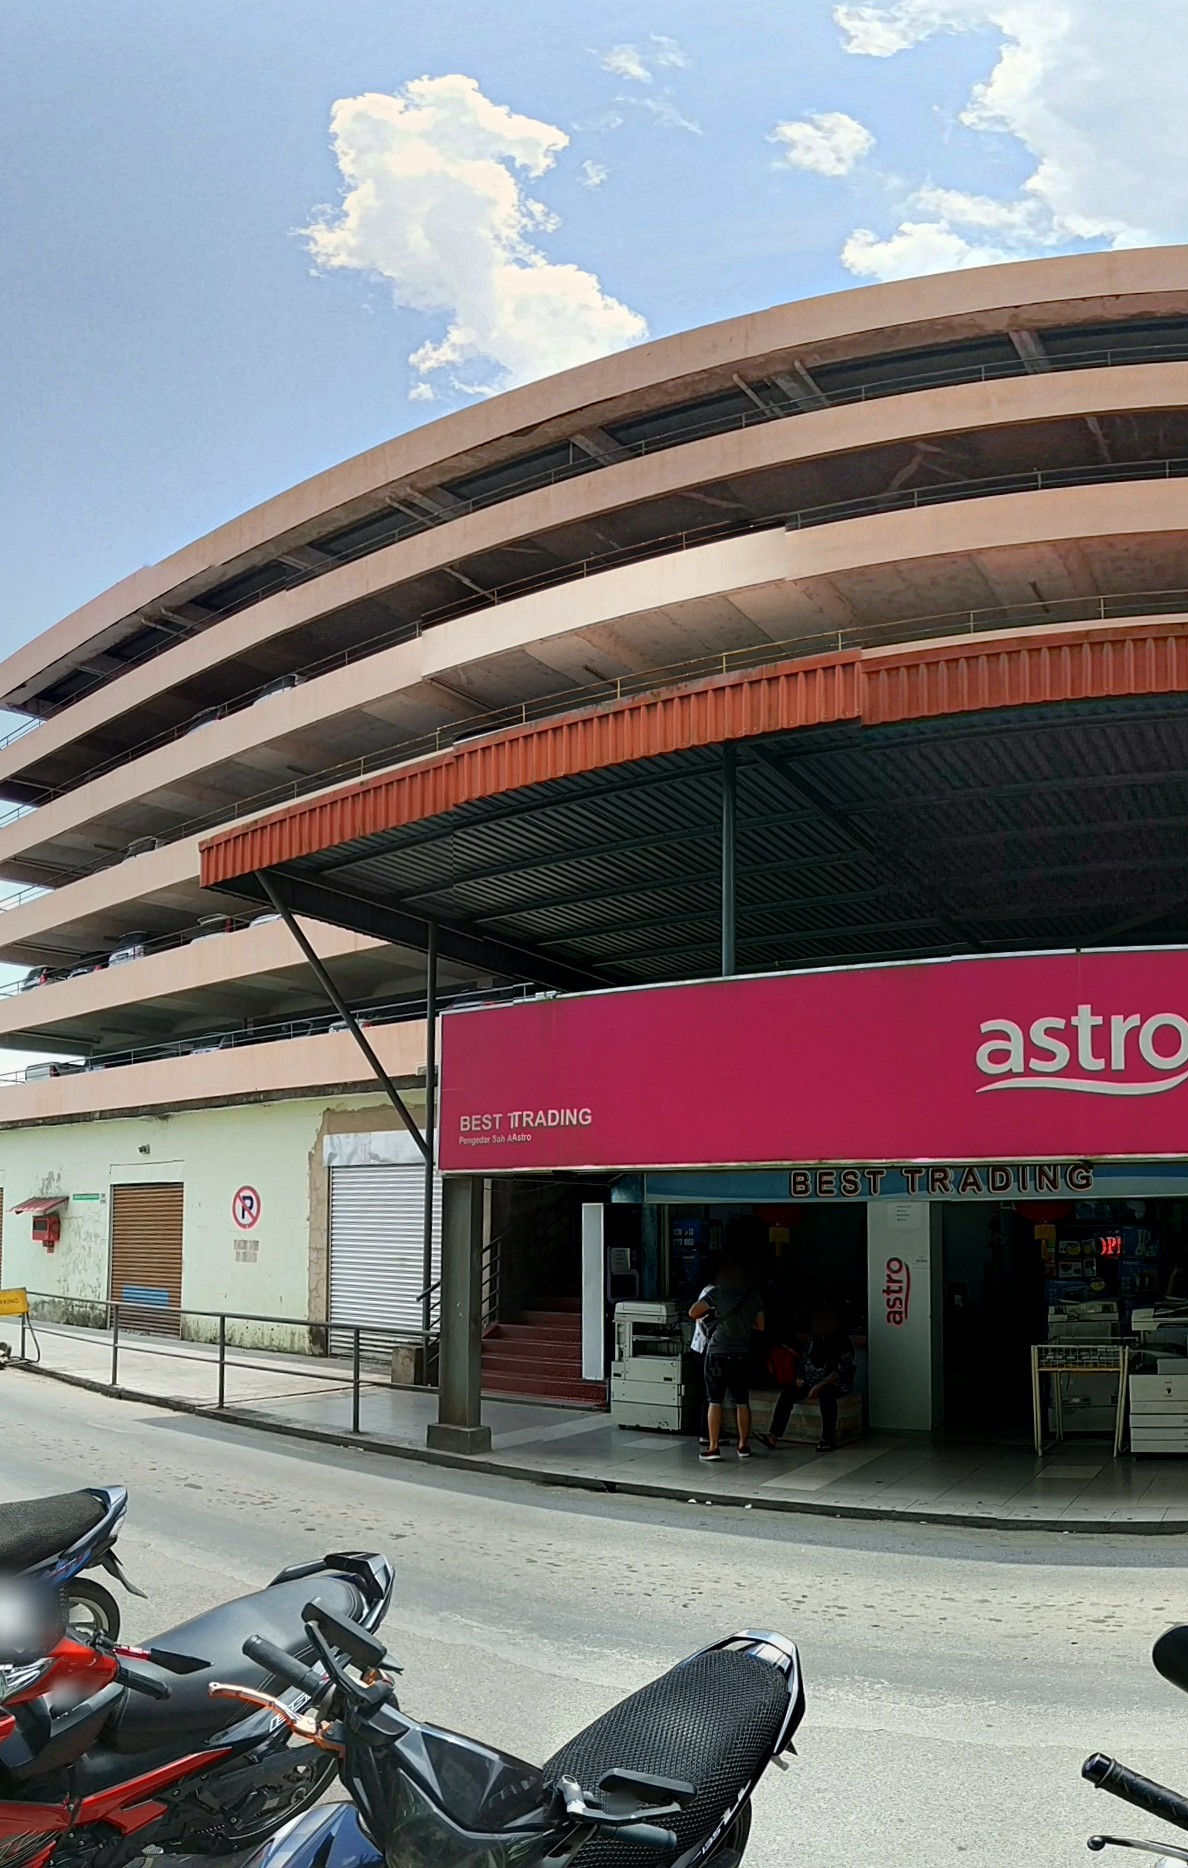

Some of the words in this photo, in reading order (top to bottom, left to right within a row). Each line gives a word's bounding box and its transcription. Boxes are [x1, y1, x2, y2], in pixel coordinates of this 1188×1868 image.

[460, 1113, 503, 1132] BEST
[458, 1135, 491, 1147] Pengedar
[492, 1135, 505, 1144] Sah
[789, 1168, 887, 1198] BEST
[902, 1163, 1094, 1195] TRADING
[882, 1257, 903, 1326] astro
